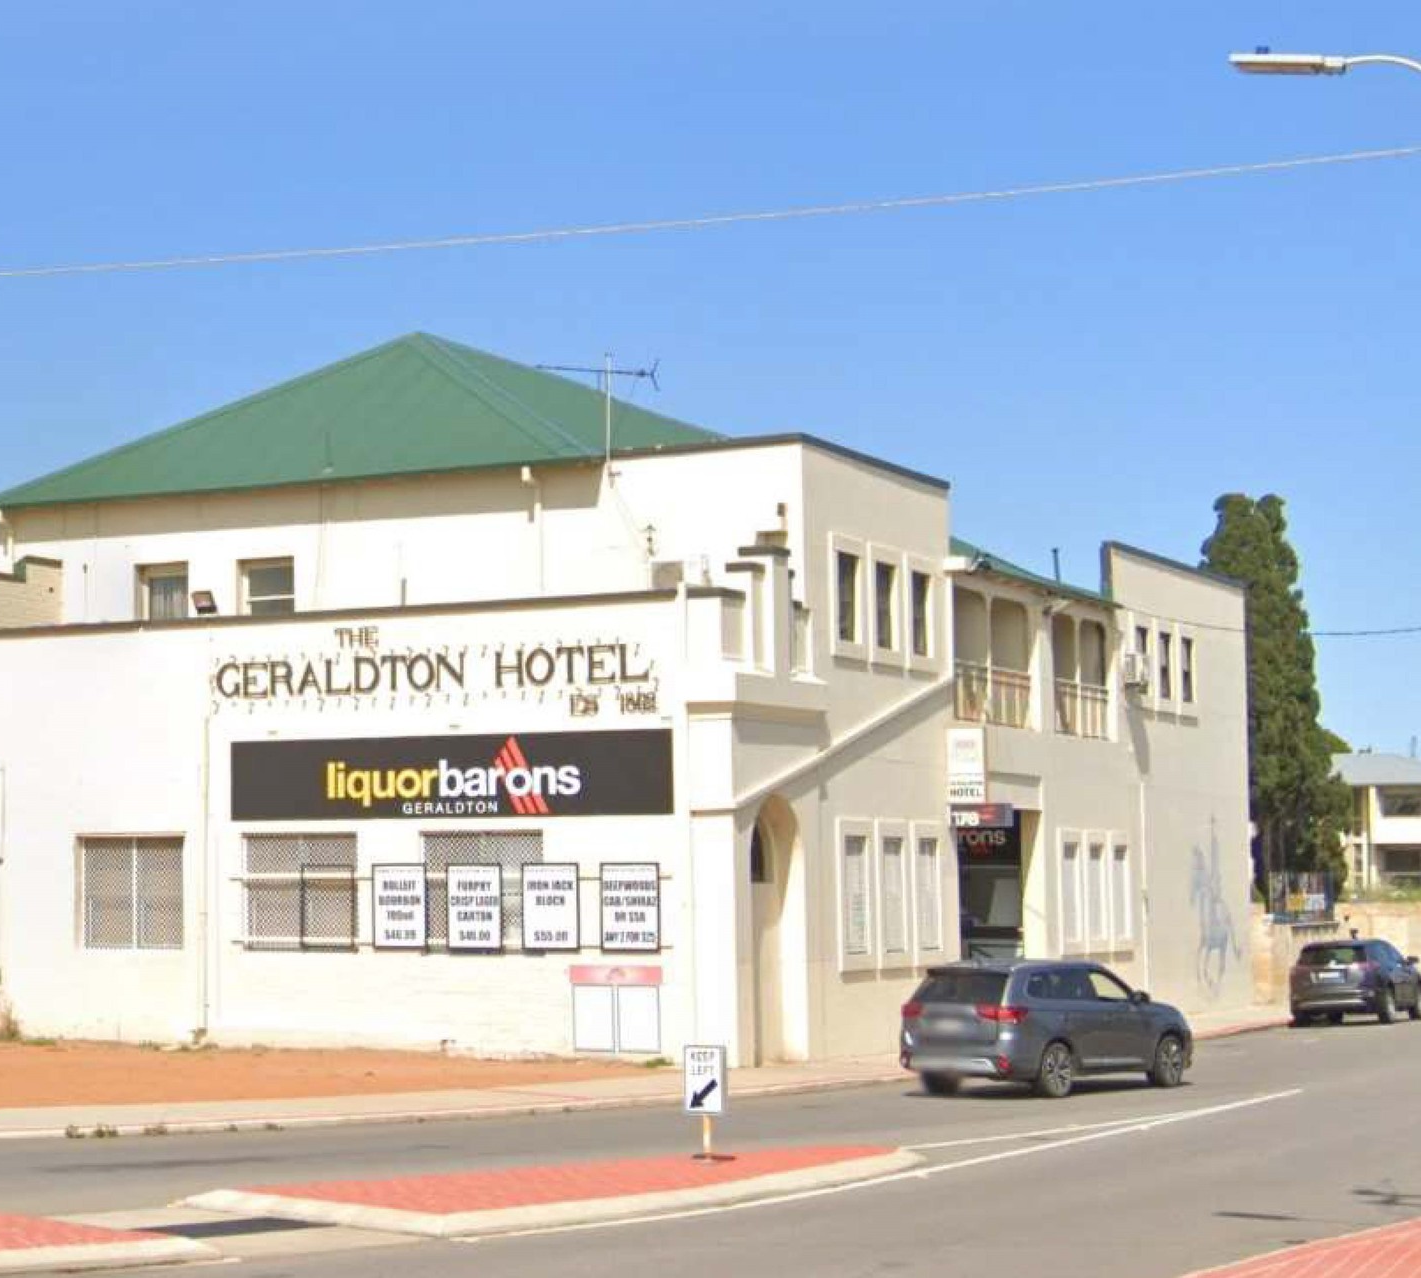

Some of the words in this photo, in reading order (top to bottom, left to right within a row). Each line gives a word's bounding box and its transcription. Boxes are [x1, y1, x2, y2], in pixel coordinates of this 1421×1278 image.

[334, 626, 379, 648] THE
[215, 651, 467, 699] GERALDTON
[495, 644, 649, 688] HOTEL
[326, 759, 581, 807] liquorbarons
[950, 787, 982, 797] HOTEL
[402, 801, 498, 815] GERALDTON
[536, 896, 565, 906] BLOCK
[458, 911, 492, 921] CARTON
[690, 1051, 715, 1062] KEEP
[689, 1065, 715, 1076] LEFT
